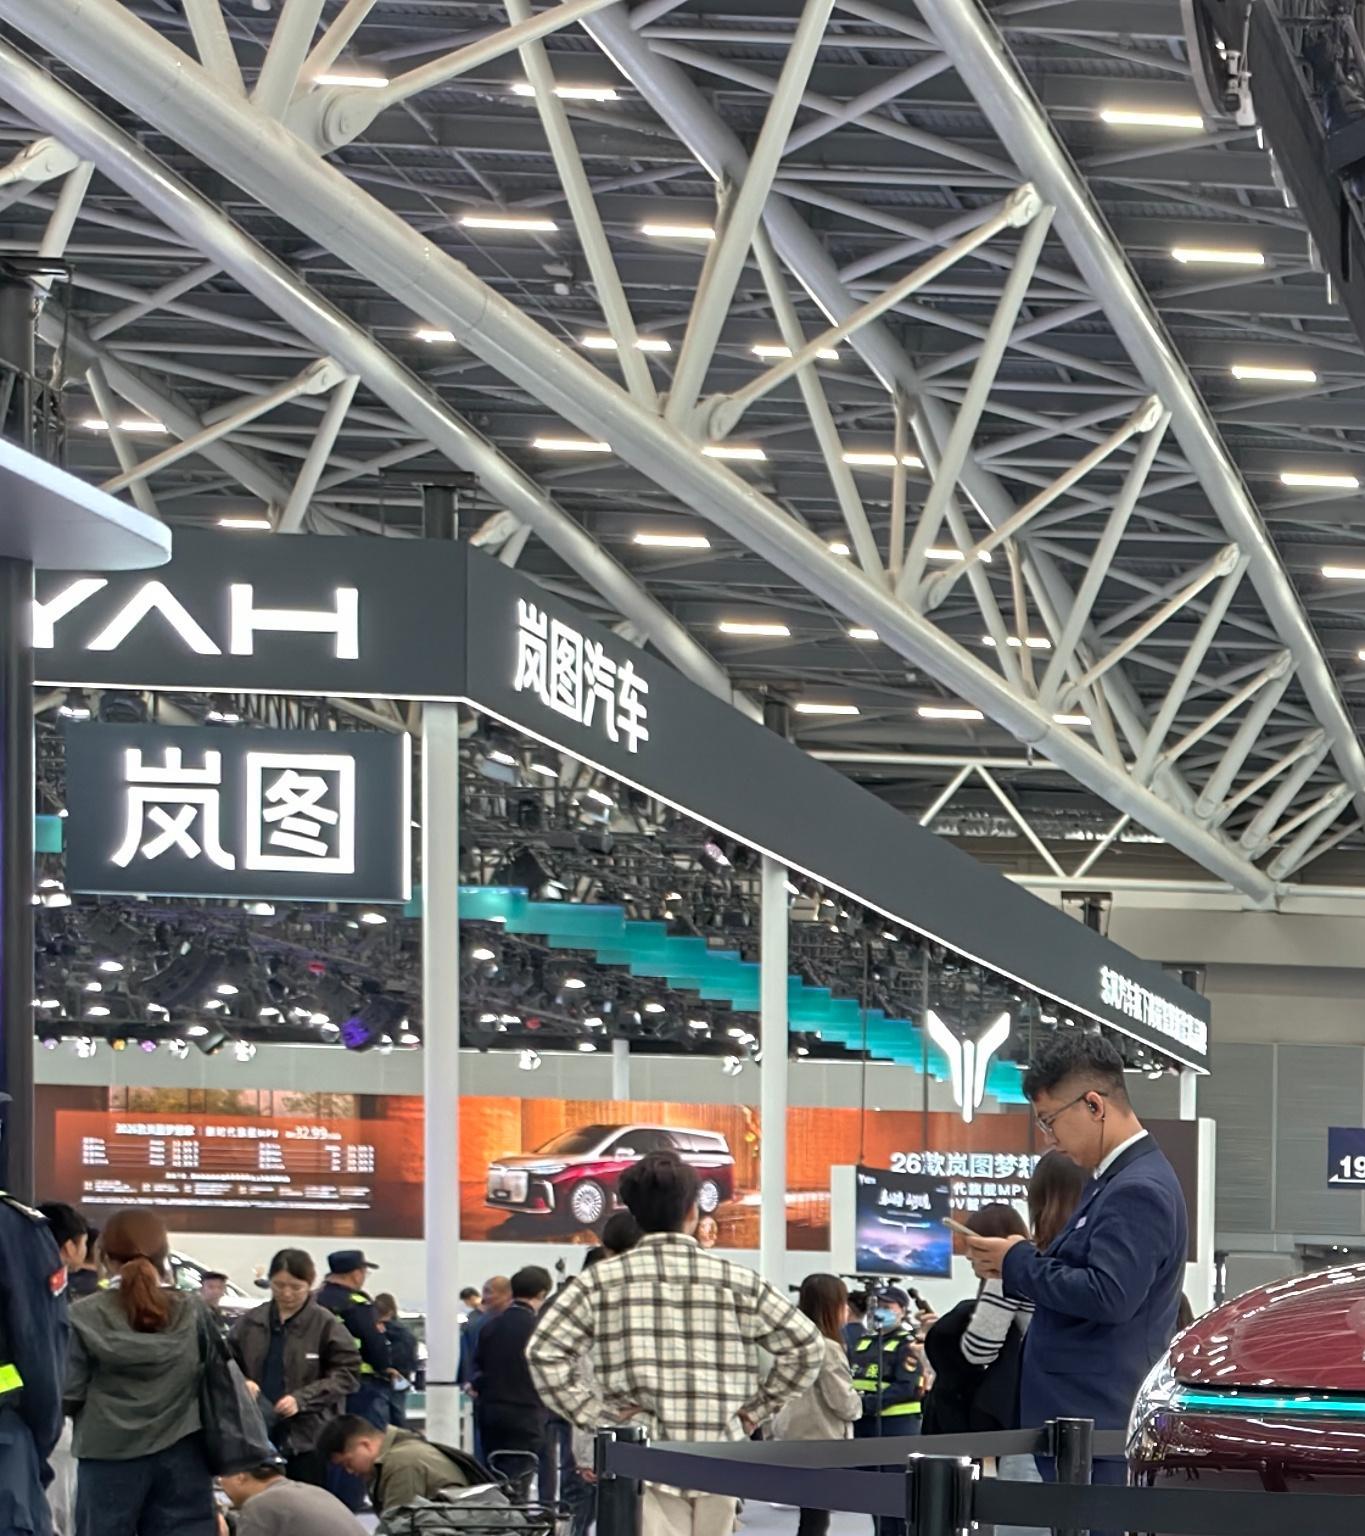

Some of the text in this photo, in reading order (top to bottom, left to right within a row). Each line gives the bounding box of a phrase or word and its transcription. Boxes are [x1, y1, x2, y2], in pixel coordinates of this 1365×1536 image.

[514, 598, 650, 754] 岚图汽车
[112, 746, 355, 875] 岚图
